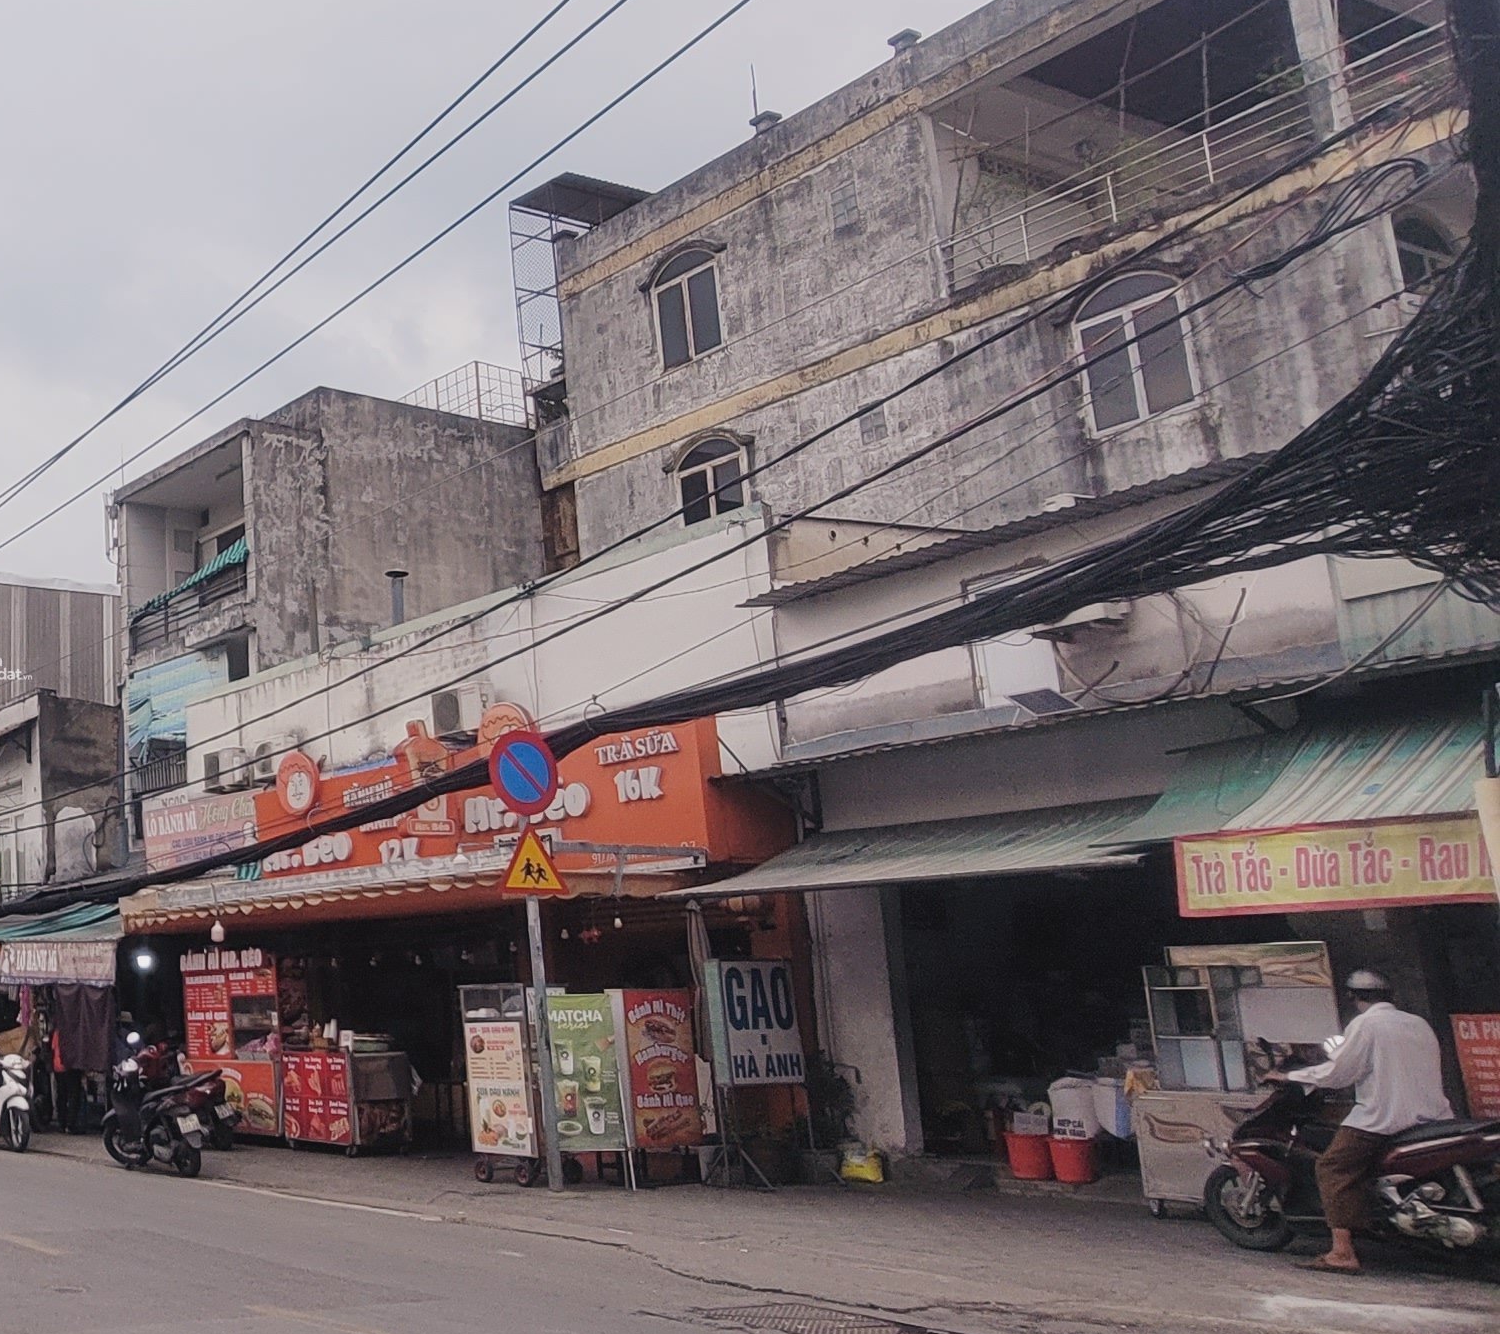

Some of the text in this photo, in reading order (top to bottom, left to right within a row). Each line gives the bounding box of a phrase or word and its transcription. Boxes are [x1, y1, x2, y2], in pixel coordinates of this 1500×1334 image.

[594, 735, 634, 766] TRÀ
[613, 766, 664, 804] 16K
[1192, 852, 1227, 895] Trà
[1232, 841, 1273, 893] Tắc
[1295, 844, 1341, 890] Dừa
[1348, 832, 1392, 886] Tắc
[1418, 837, 1470, 882] Rau
[548, 1009, 603, 1022] MATCHA
